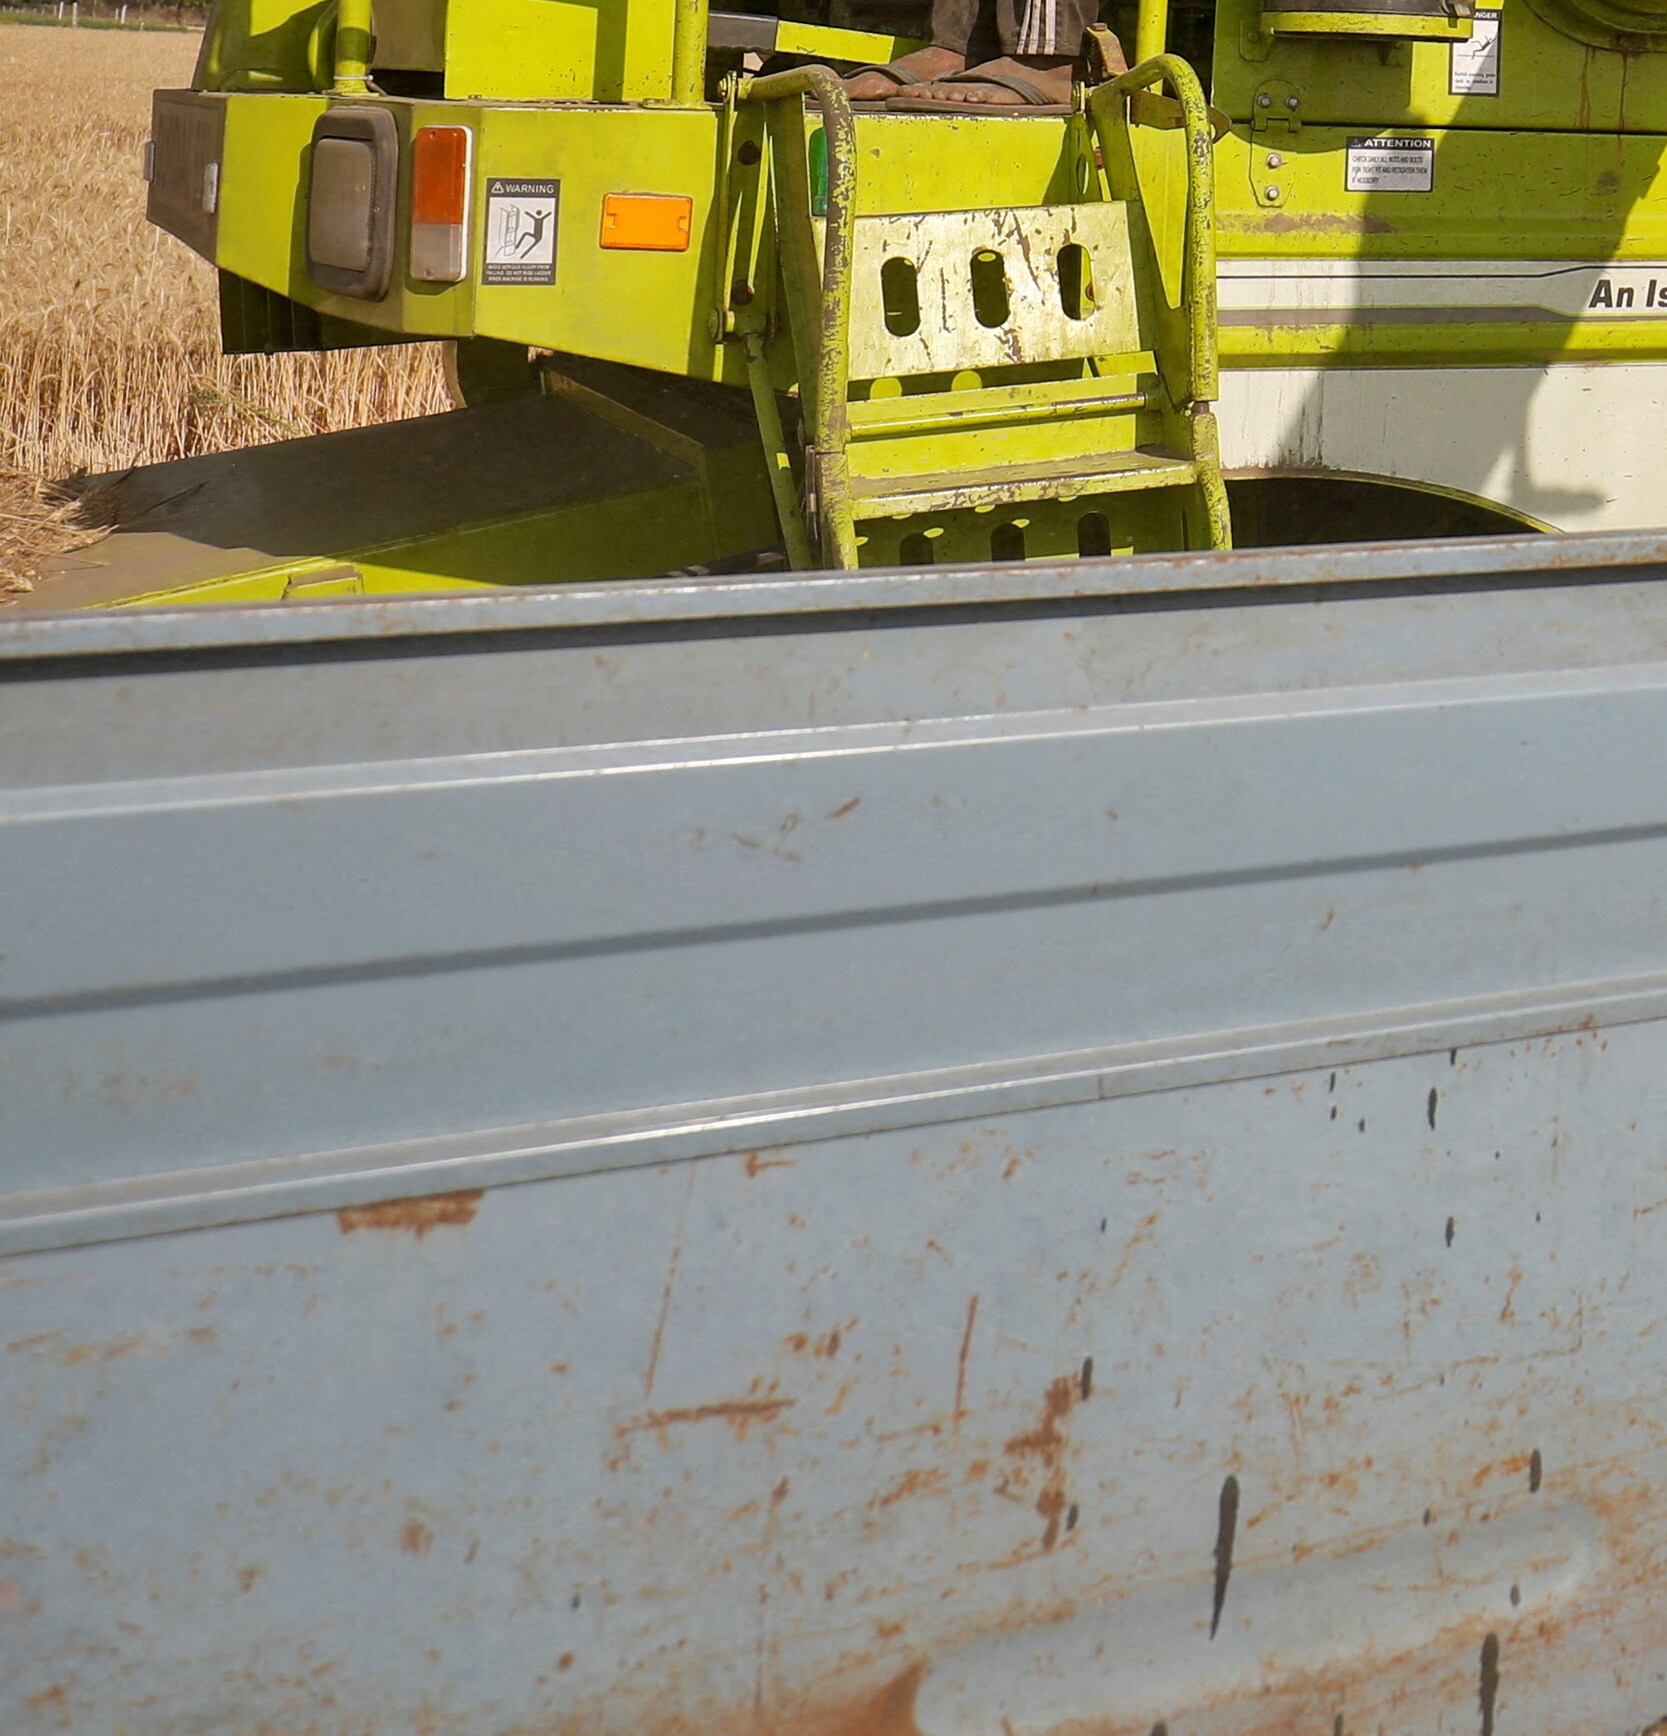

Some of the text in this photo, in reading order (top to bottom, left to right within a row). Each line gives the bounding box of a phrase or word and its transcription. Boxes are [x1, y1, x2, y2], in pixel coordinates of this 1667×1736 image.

[1474, 11, 1498, 19] NGER
[1364, 138, 1431, 148] ATTENTION
[505, 184, 554, 194] WARNING
[1588, 278, 1635, 309] An
